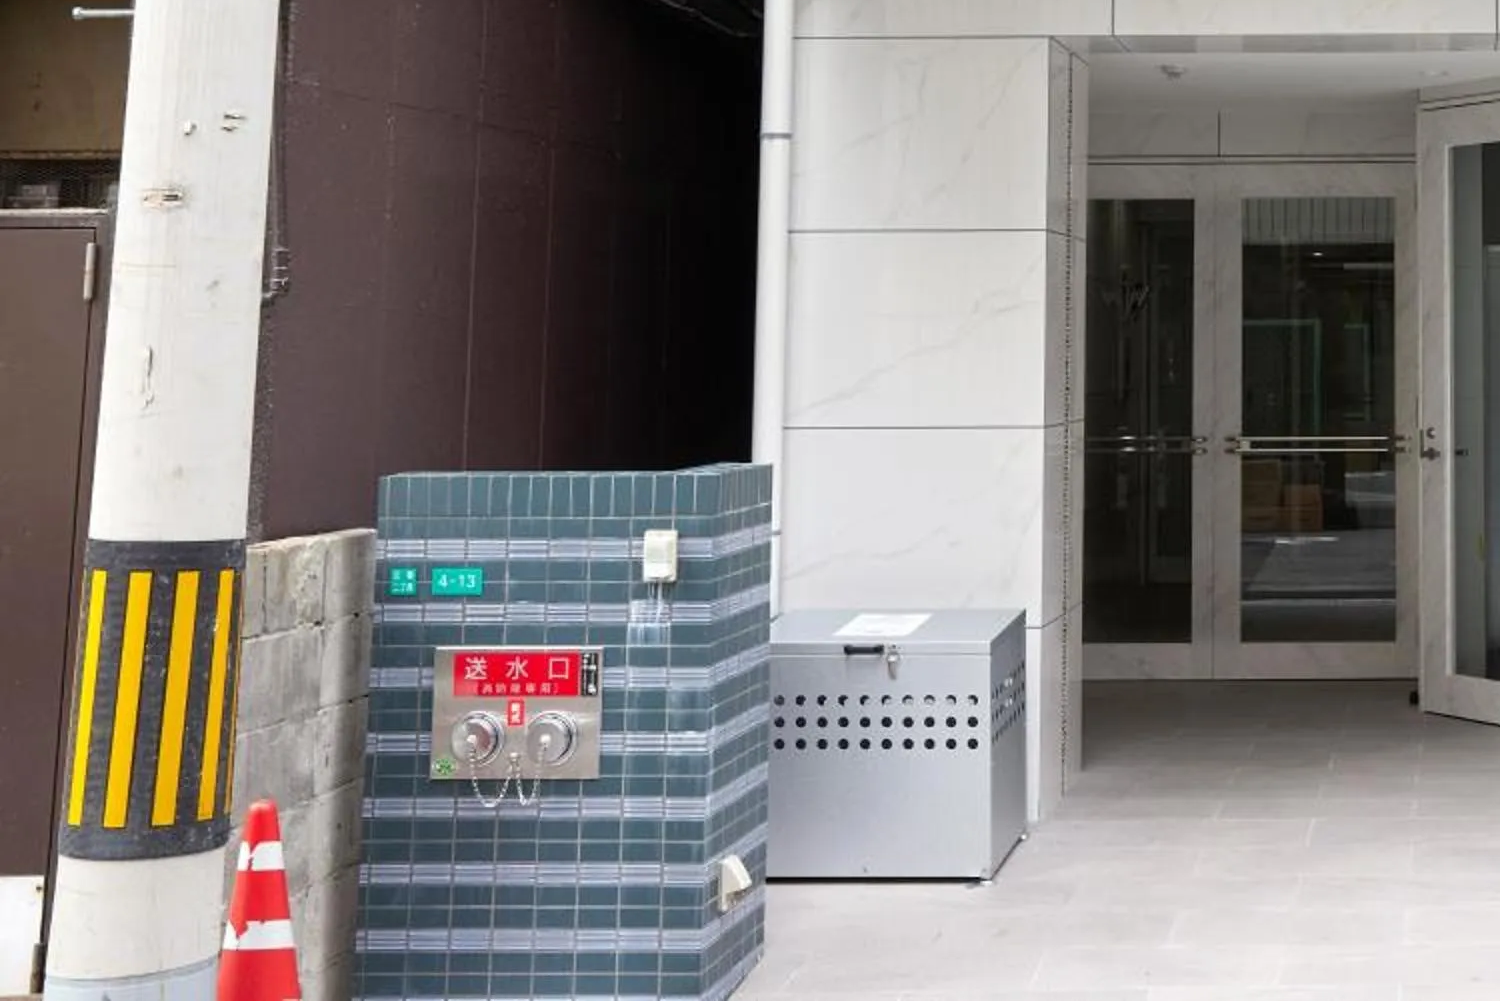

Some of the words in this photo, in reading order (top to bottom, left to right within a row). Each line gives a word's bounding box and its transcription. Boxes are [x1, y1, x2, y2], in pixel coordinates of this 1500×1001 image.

[437, 574, 477, 588] 4-13
[464, 655, 570, 680] 送水口
